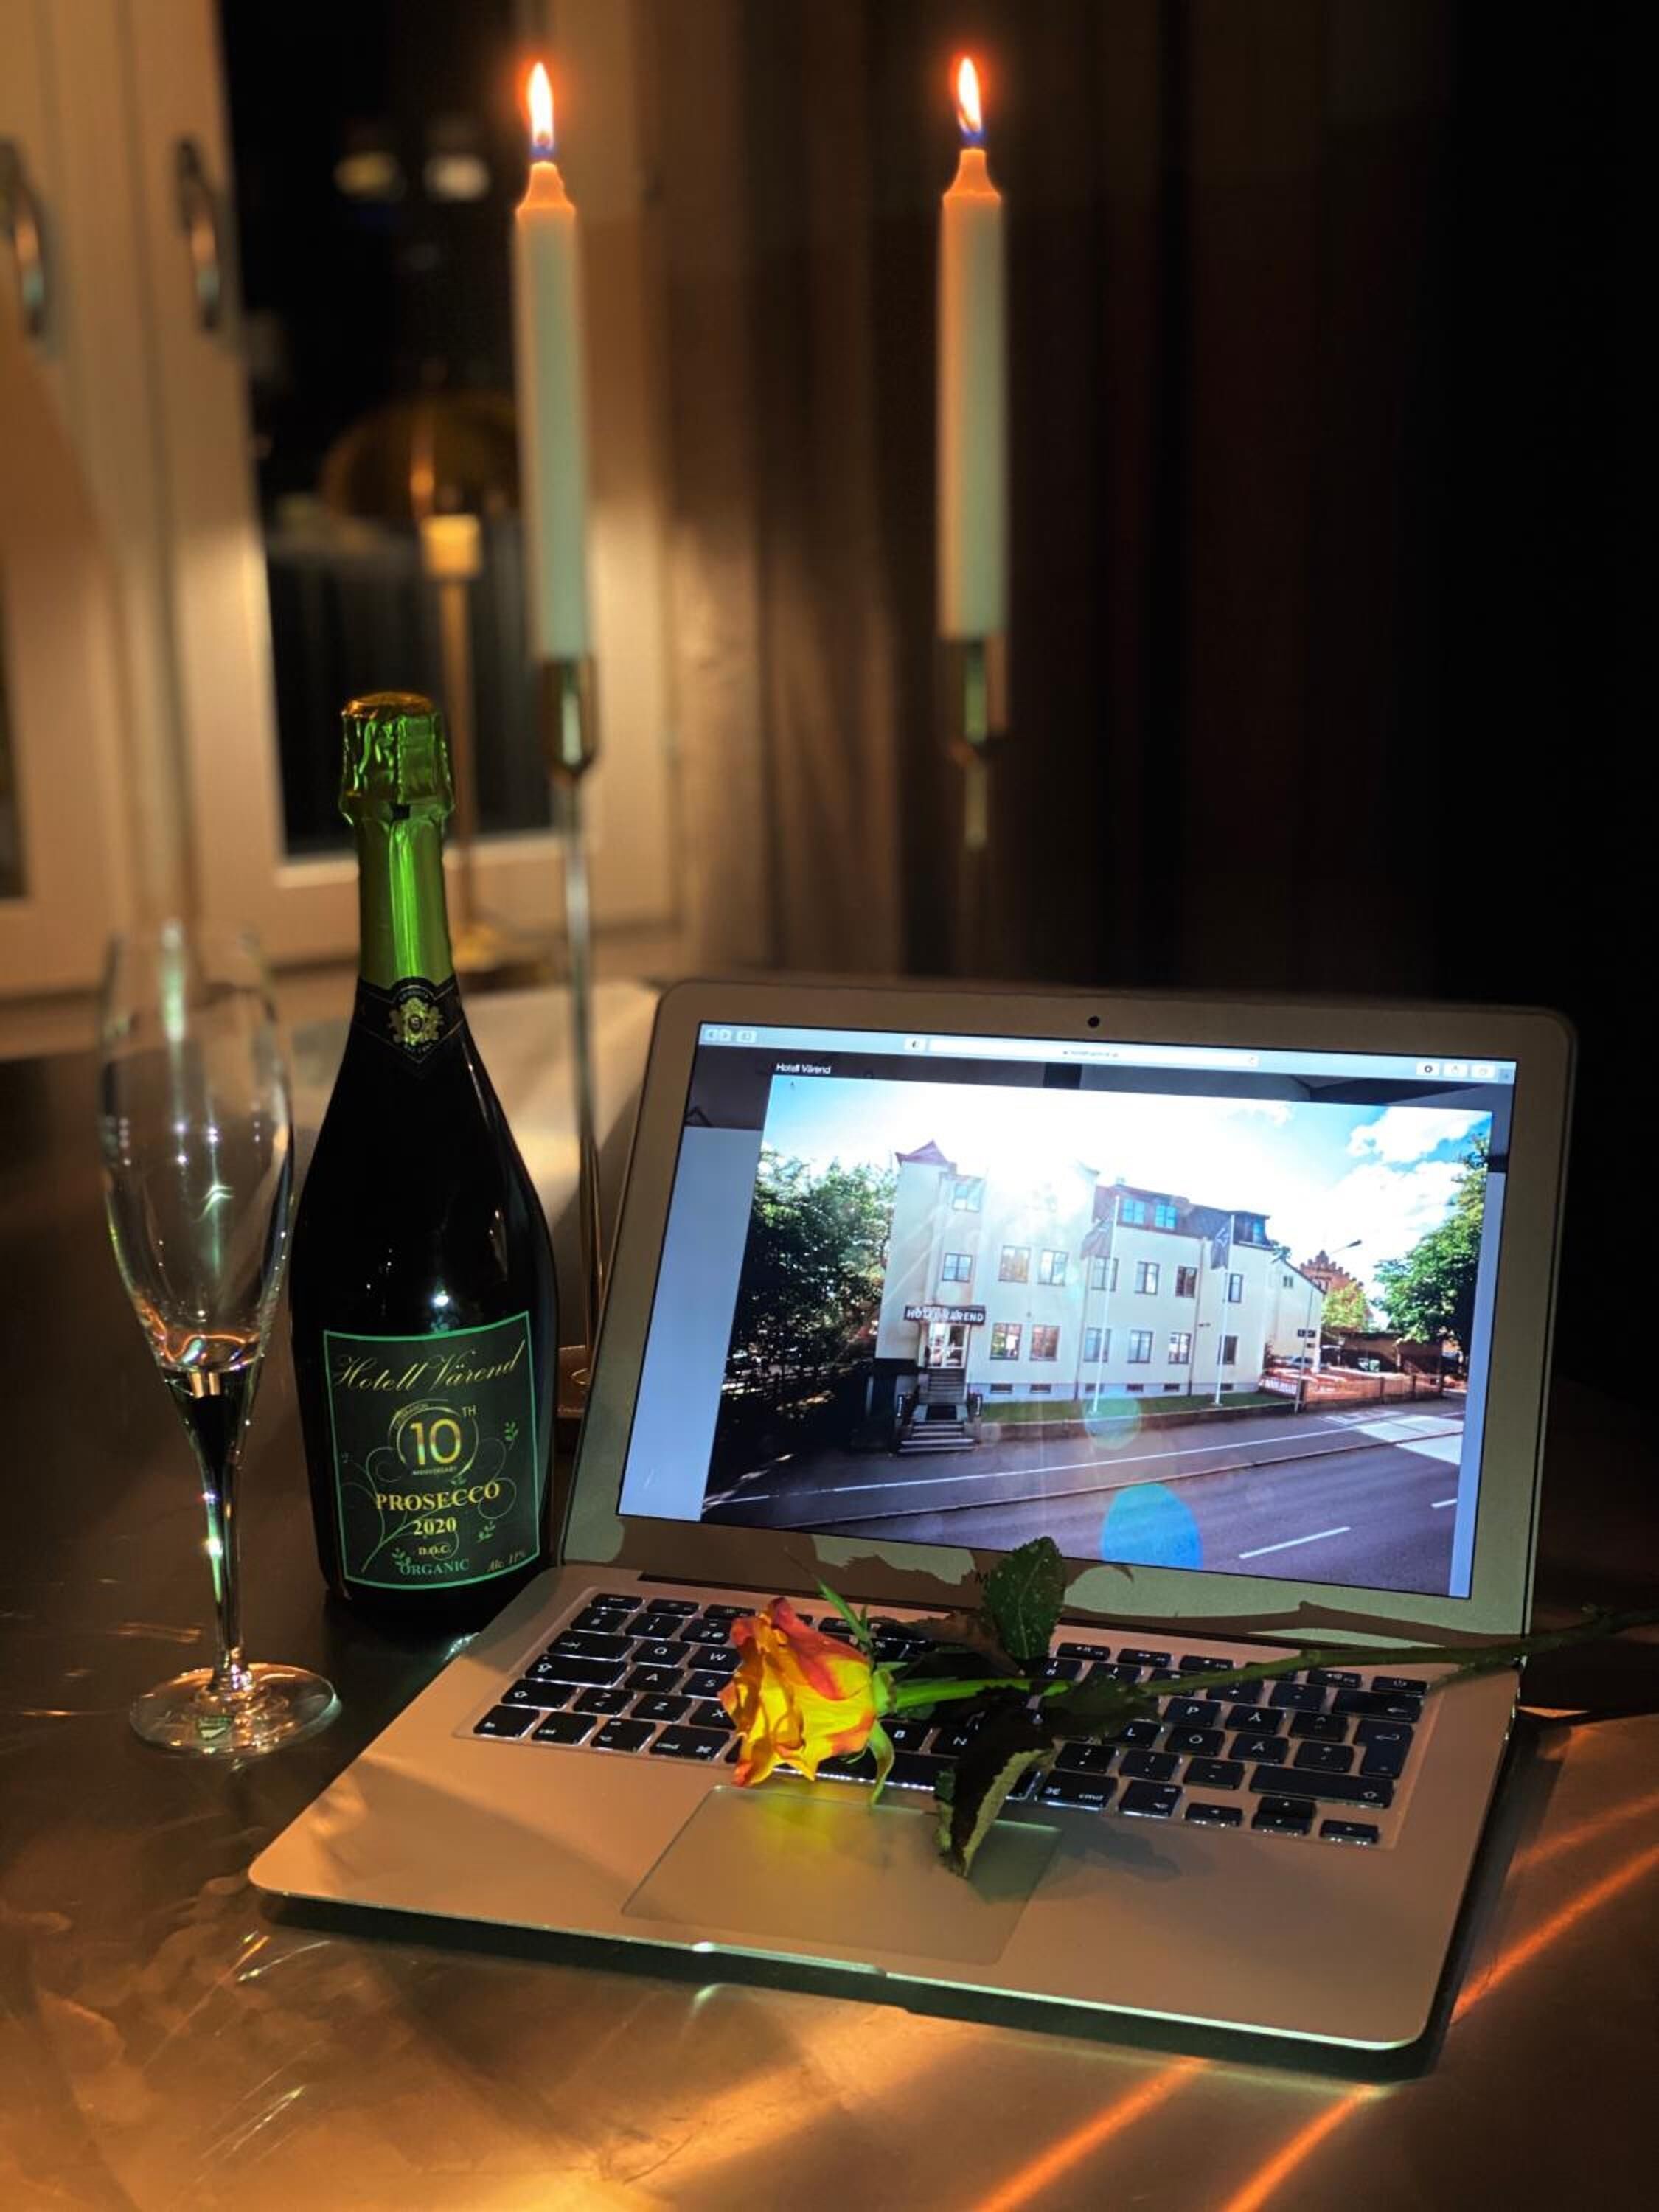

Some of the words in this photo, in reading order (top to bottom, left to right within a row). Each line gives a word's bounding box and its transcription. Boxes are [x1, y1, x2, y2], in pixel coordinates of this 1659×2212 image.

[776, 1062, 800, 1073] Hotell
[334, 1356, 428, 1392] Hotell
[424, 1338, 526, 1392] Värend
[409, 1418, 462, 1466] 10
[461, 1404, 477, 1416] TH
[376, 1481, 501, 1511] PROSECCO
[413, 1517, 457, 1536] 2020
[400, 1559, 470, 1576] ORGANIC
[653, 1646, 668, 1656] Q
[709, 1652, 727, 1661] W
[644, 1673, 659, 1682] A
[703, 1679, 717, 1688] S
[653, 1702, 669, 1711] Z
[1186, 1705, 1200, 1715] P
[711, 1708, 726, 1718] X
[1127, 1728, 1136, 1736] L
[1079, 1792, 1105, 1801] cmd
